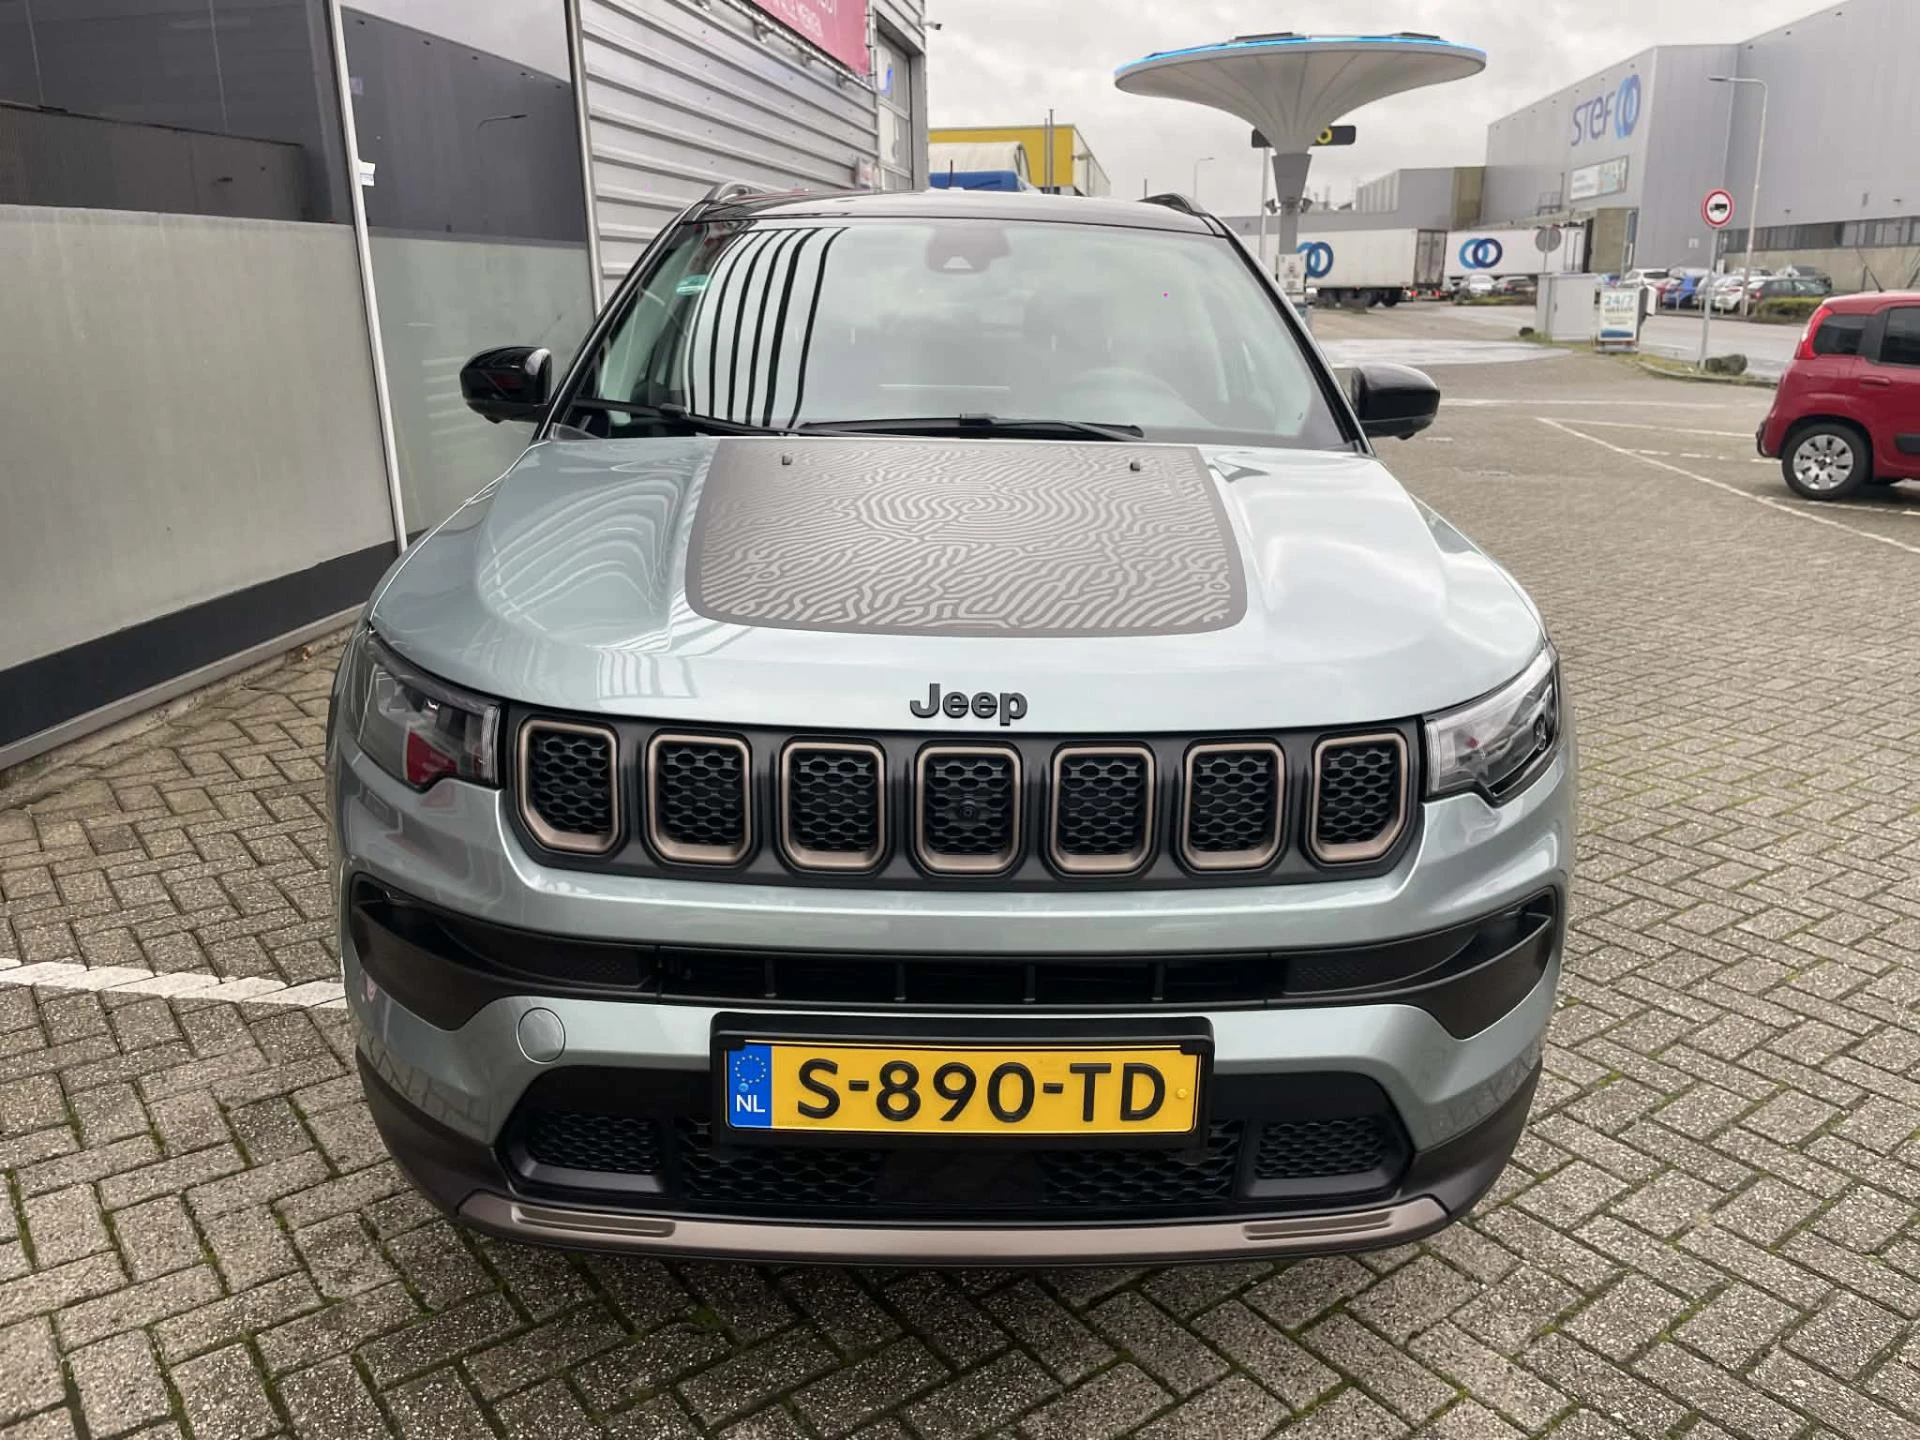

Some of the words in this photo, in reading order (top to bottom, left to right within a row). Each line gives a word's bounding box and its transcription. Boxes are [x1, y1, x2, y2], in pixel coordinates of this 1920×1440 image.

[909, 682, 1028, 727] Jeep
[736, 1094, 766, 1113] NL
[796, 1058, 1166, 1123] S-890-TD
